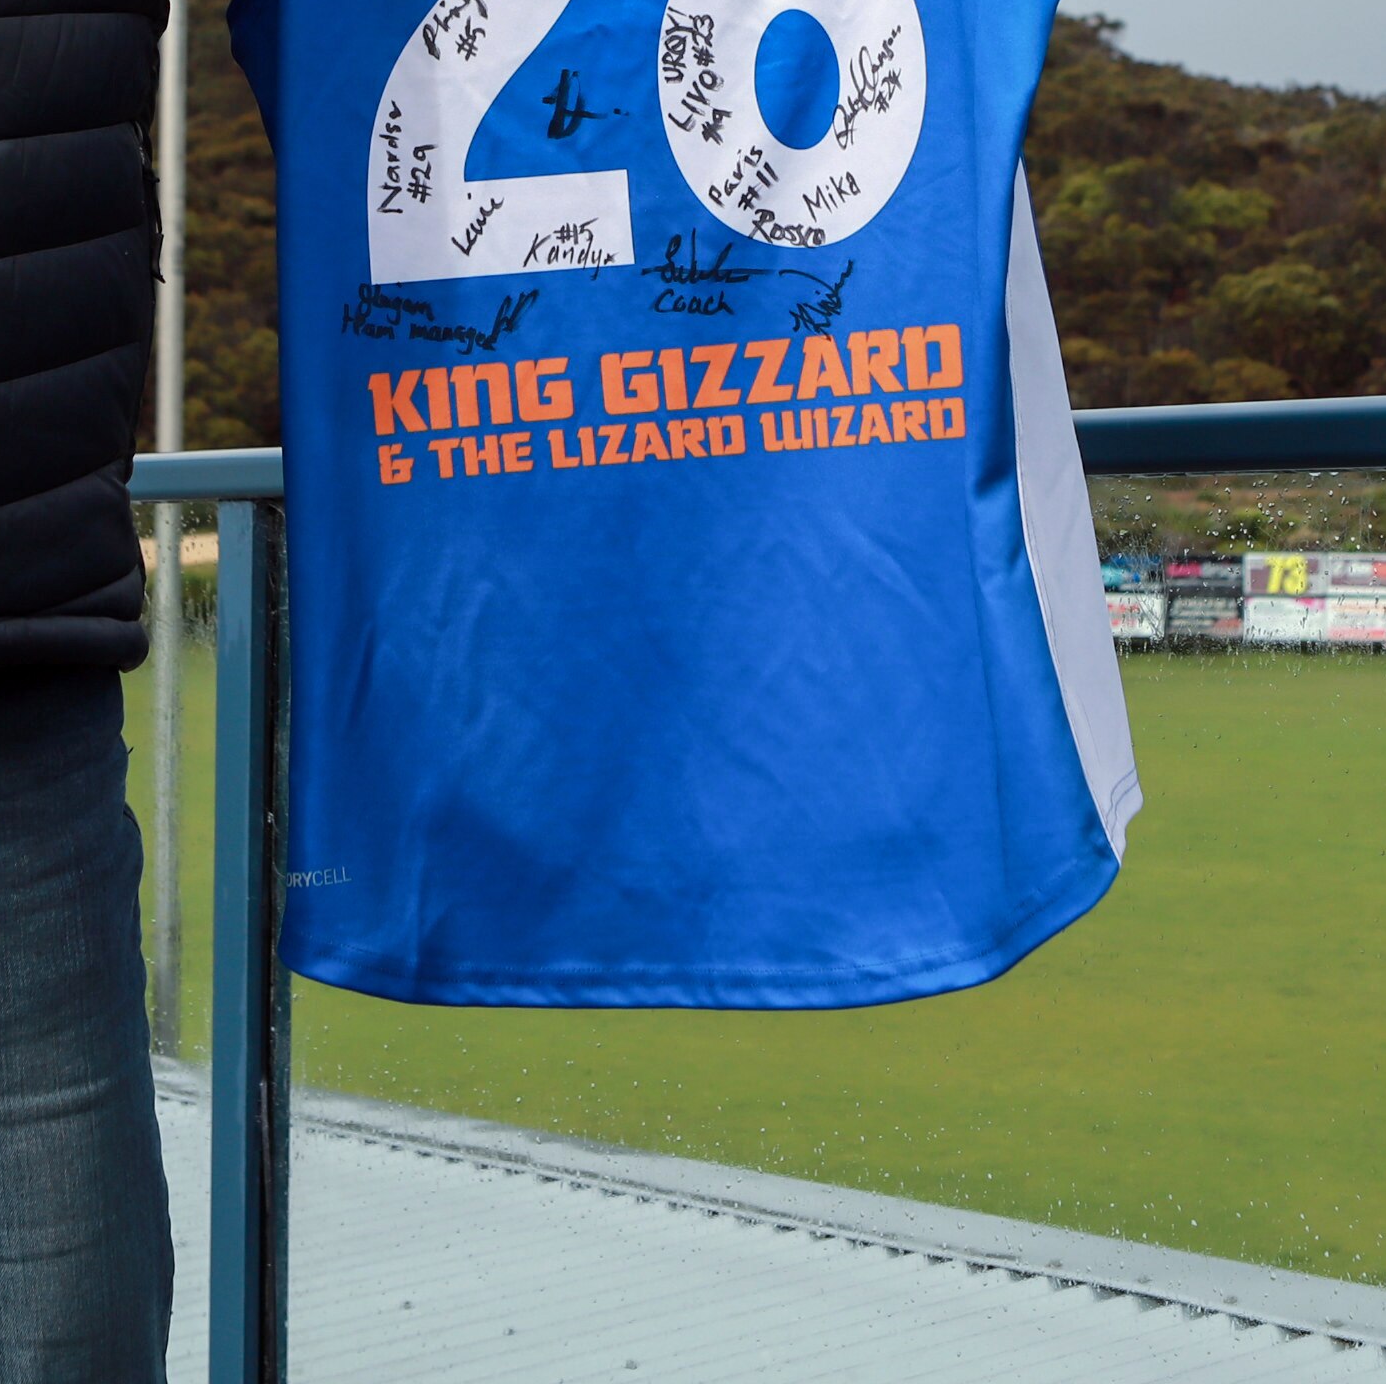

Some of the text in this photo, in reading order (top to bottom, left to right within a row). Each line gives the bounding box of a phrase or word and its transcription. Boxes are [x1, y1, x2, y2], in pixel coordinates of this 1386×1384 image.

[407, 143, 439, 204] #29
[738, 162, 779, 211] #11
[554, 217, 599, 244] #15
[368, 324, 964, 436] KING GIZZARD
[378, 397, 966, 484] & THE LIZARD WIZARD
